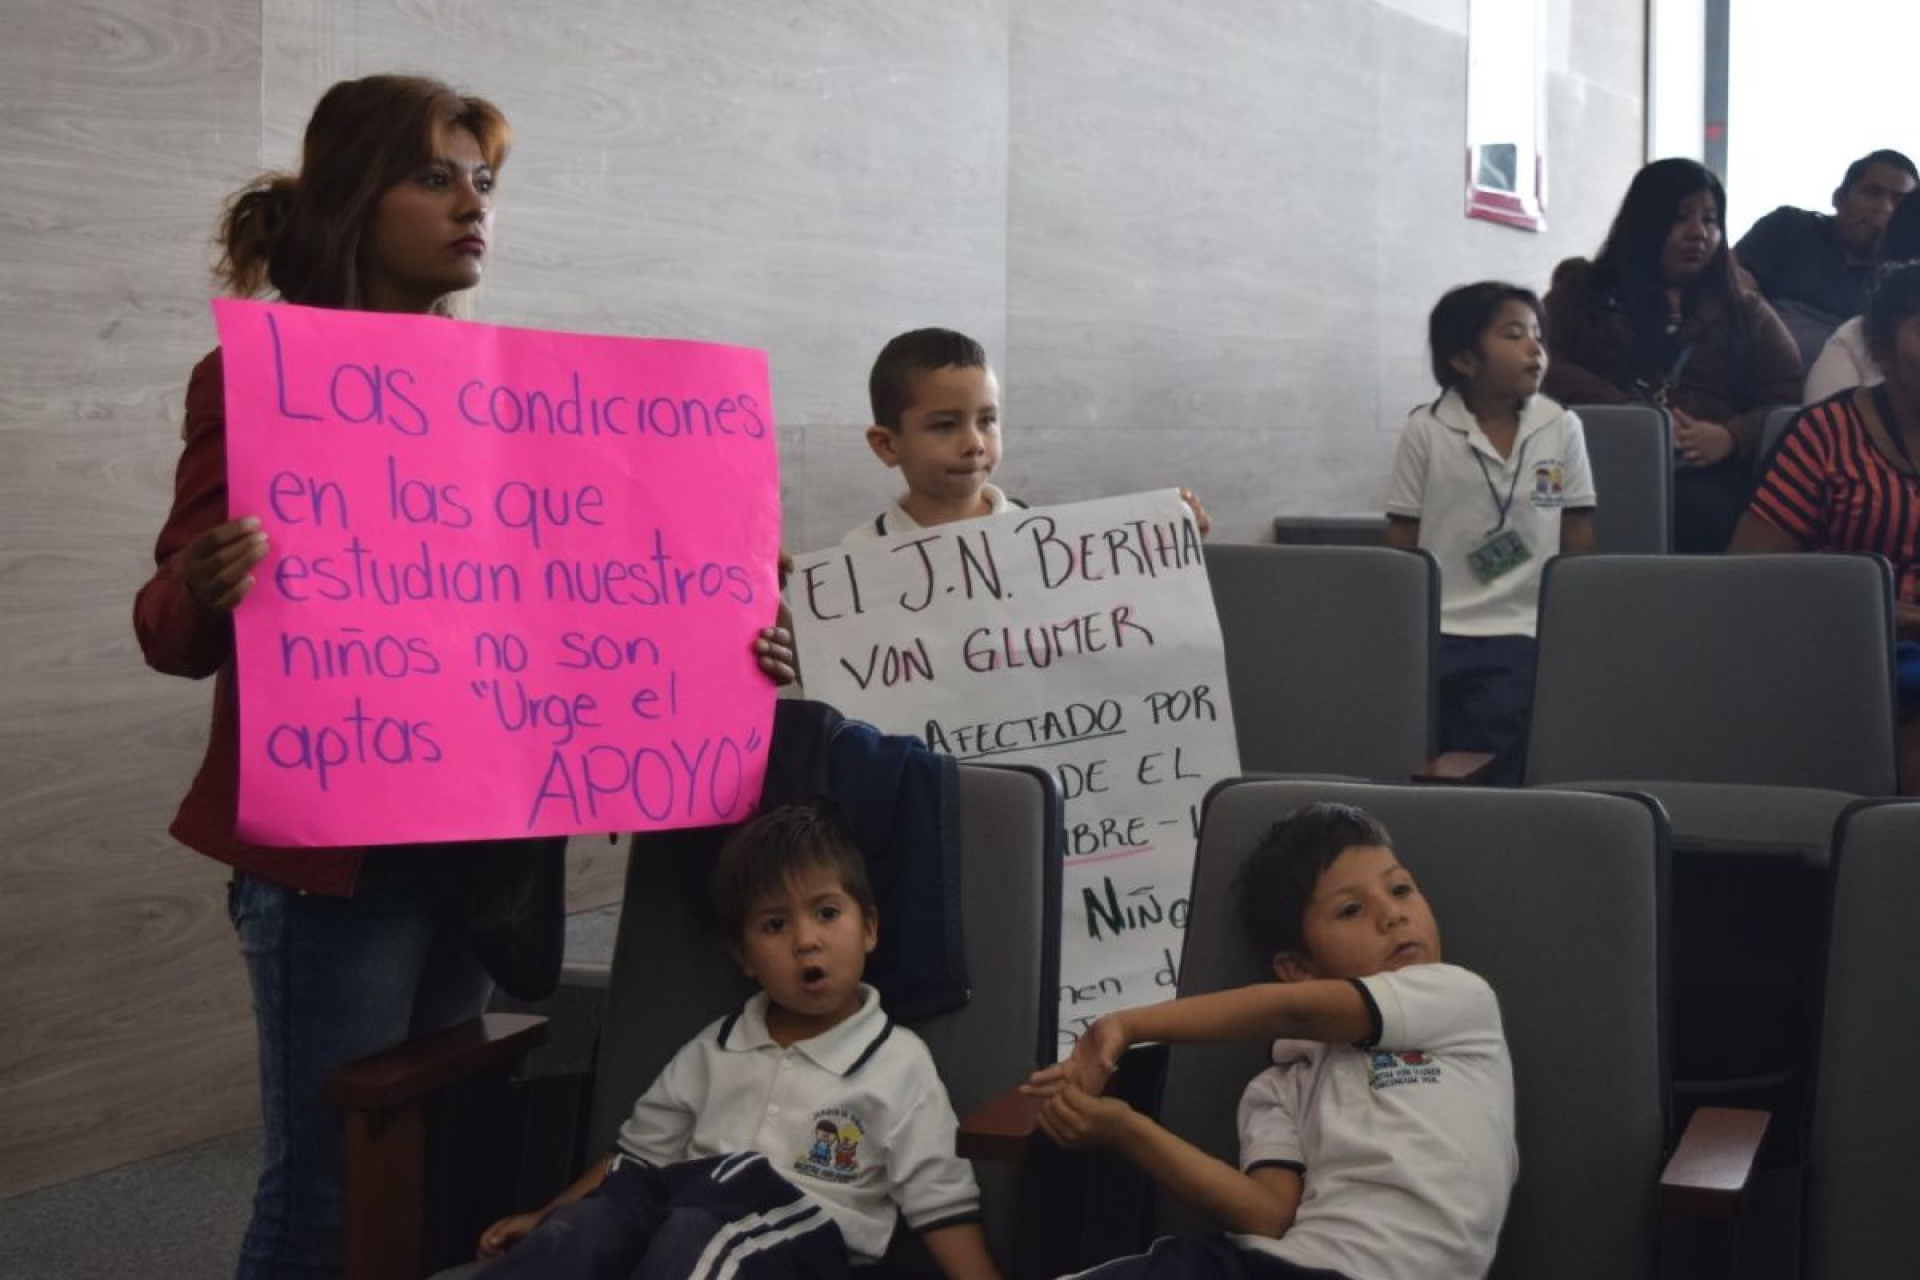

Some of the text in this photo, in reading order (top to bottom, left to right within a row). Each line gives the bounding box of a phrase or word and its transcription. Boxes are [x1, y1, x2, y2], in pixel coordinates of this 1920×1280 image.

[266, 313, 765, 438] Las condiciones
[269, 456, 605, 549] en las que
[275, 529, 755, 605] estudian nuestros
[891, 530, 1014, 612] J.N.
[1014, 515, 1202, 589] BERTHA
[281, 627, 659, 680] niños no son
[840, 605, 1154, 691] VON GLUMER
[266, 696, 442, 791] aptas
[632, 670, 676, 720] el
[924, 685, 1217, 753] AFECTADO POR
[1056, 746, 1202, 799] DE EL
